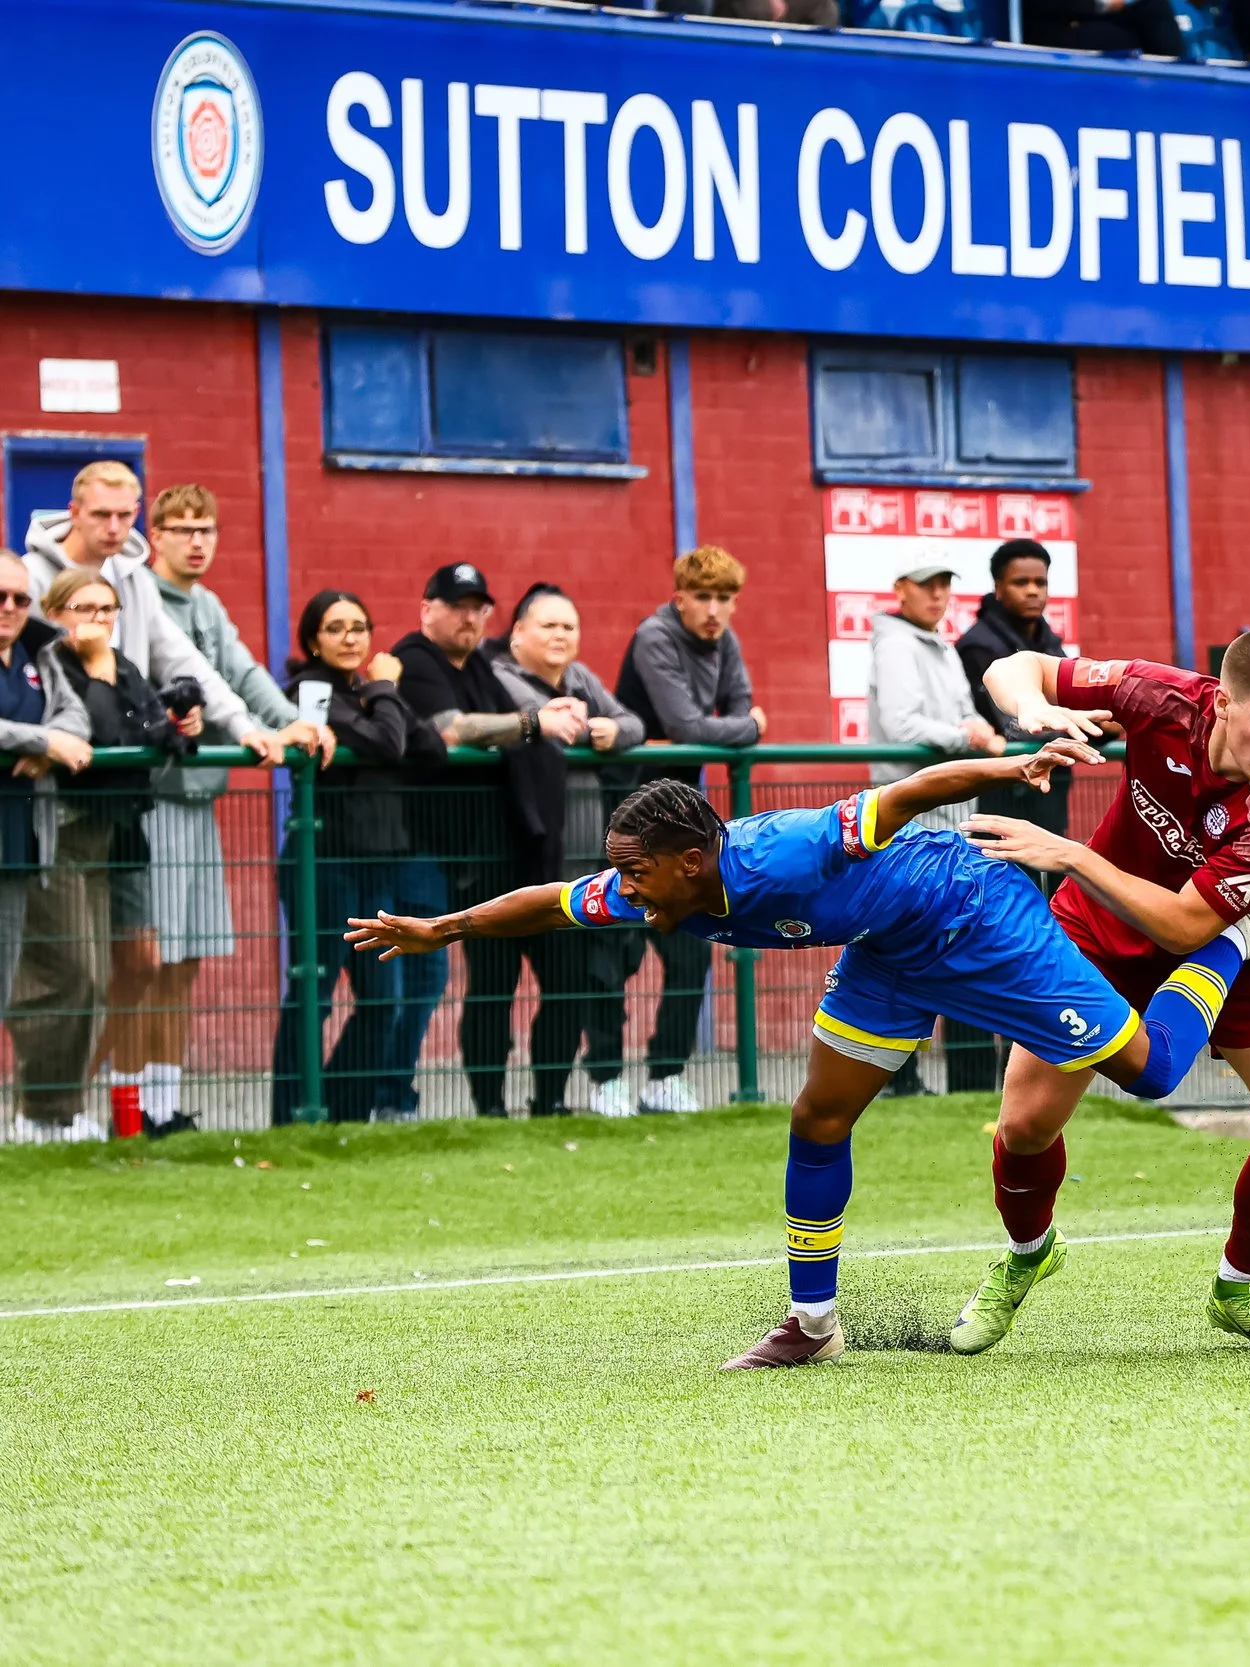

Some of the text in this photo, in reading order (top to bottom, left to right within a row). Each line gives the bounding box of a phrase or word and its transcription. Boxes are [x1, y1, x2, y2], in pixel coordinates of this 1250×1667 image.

[324, 71, 760, 263] SUTTON
[1131, 779, 1169, 827] Simply
[1059, 1008, 1088, 1036] 3
